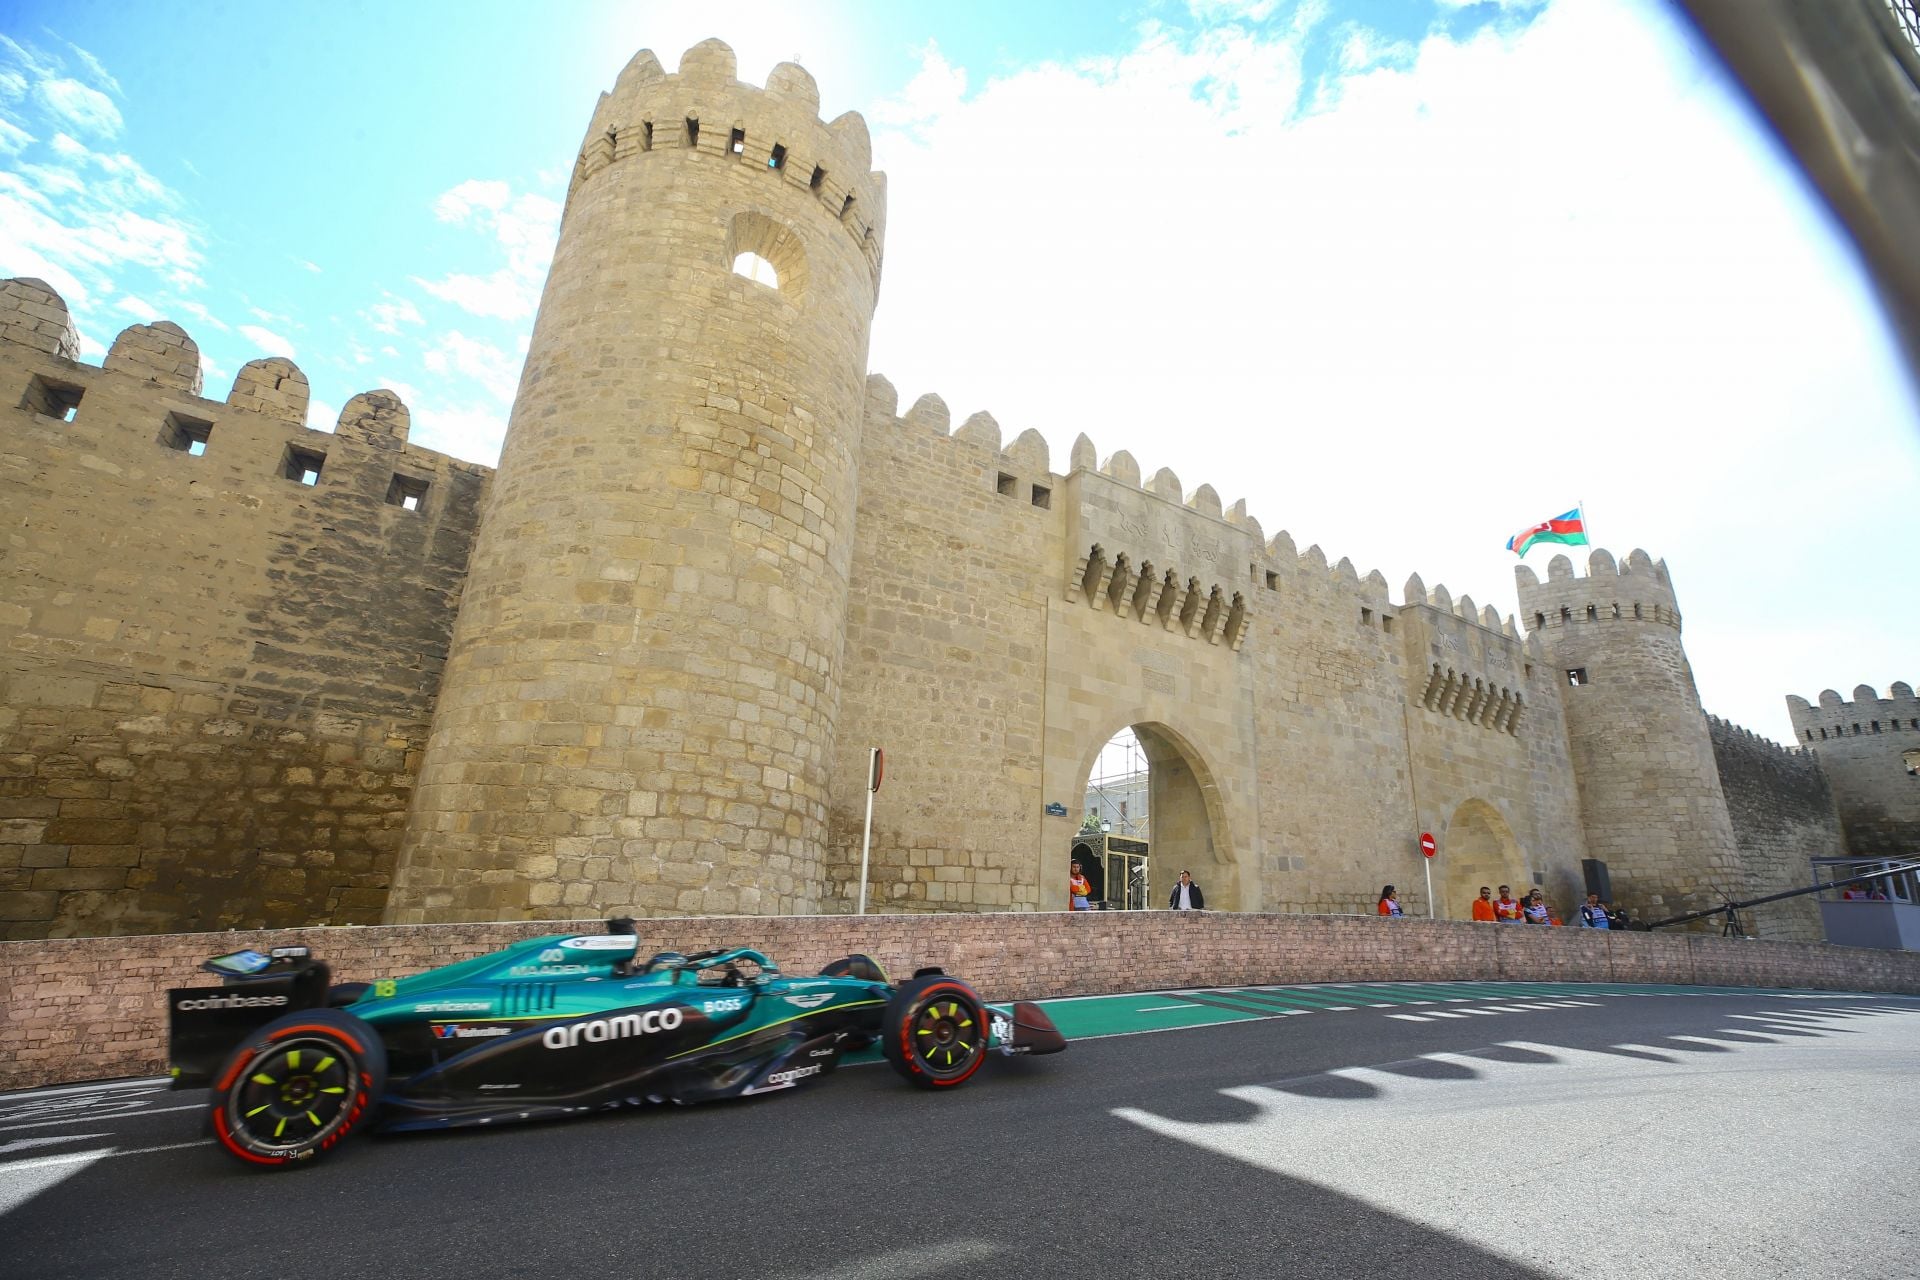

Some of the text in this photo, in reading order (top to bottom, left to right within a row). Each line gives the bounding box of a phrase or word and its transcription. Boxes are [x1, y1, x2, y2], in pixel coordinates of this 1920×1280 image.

[510, 964, 589, 976] MAADEN
[375, 980, 397, 997] 18
[177, 993, 289, 1011] coinbase
[703, 998, 742, 1013] BOSS
[543, 1007, 683, 1050] aramco
[768, 1063, 823, 1085] cognizant
